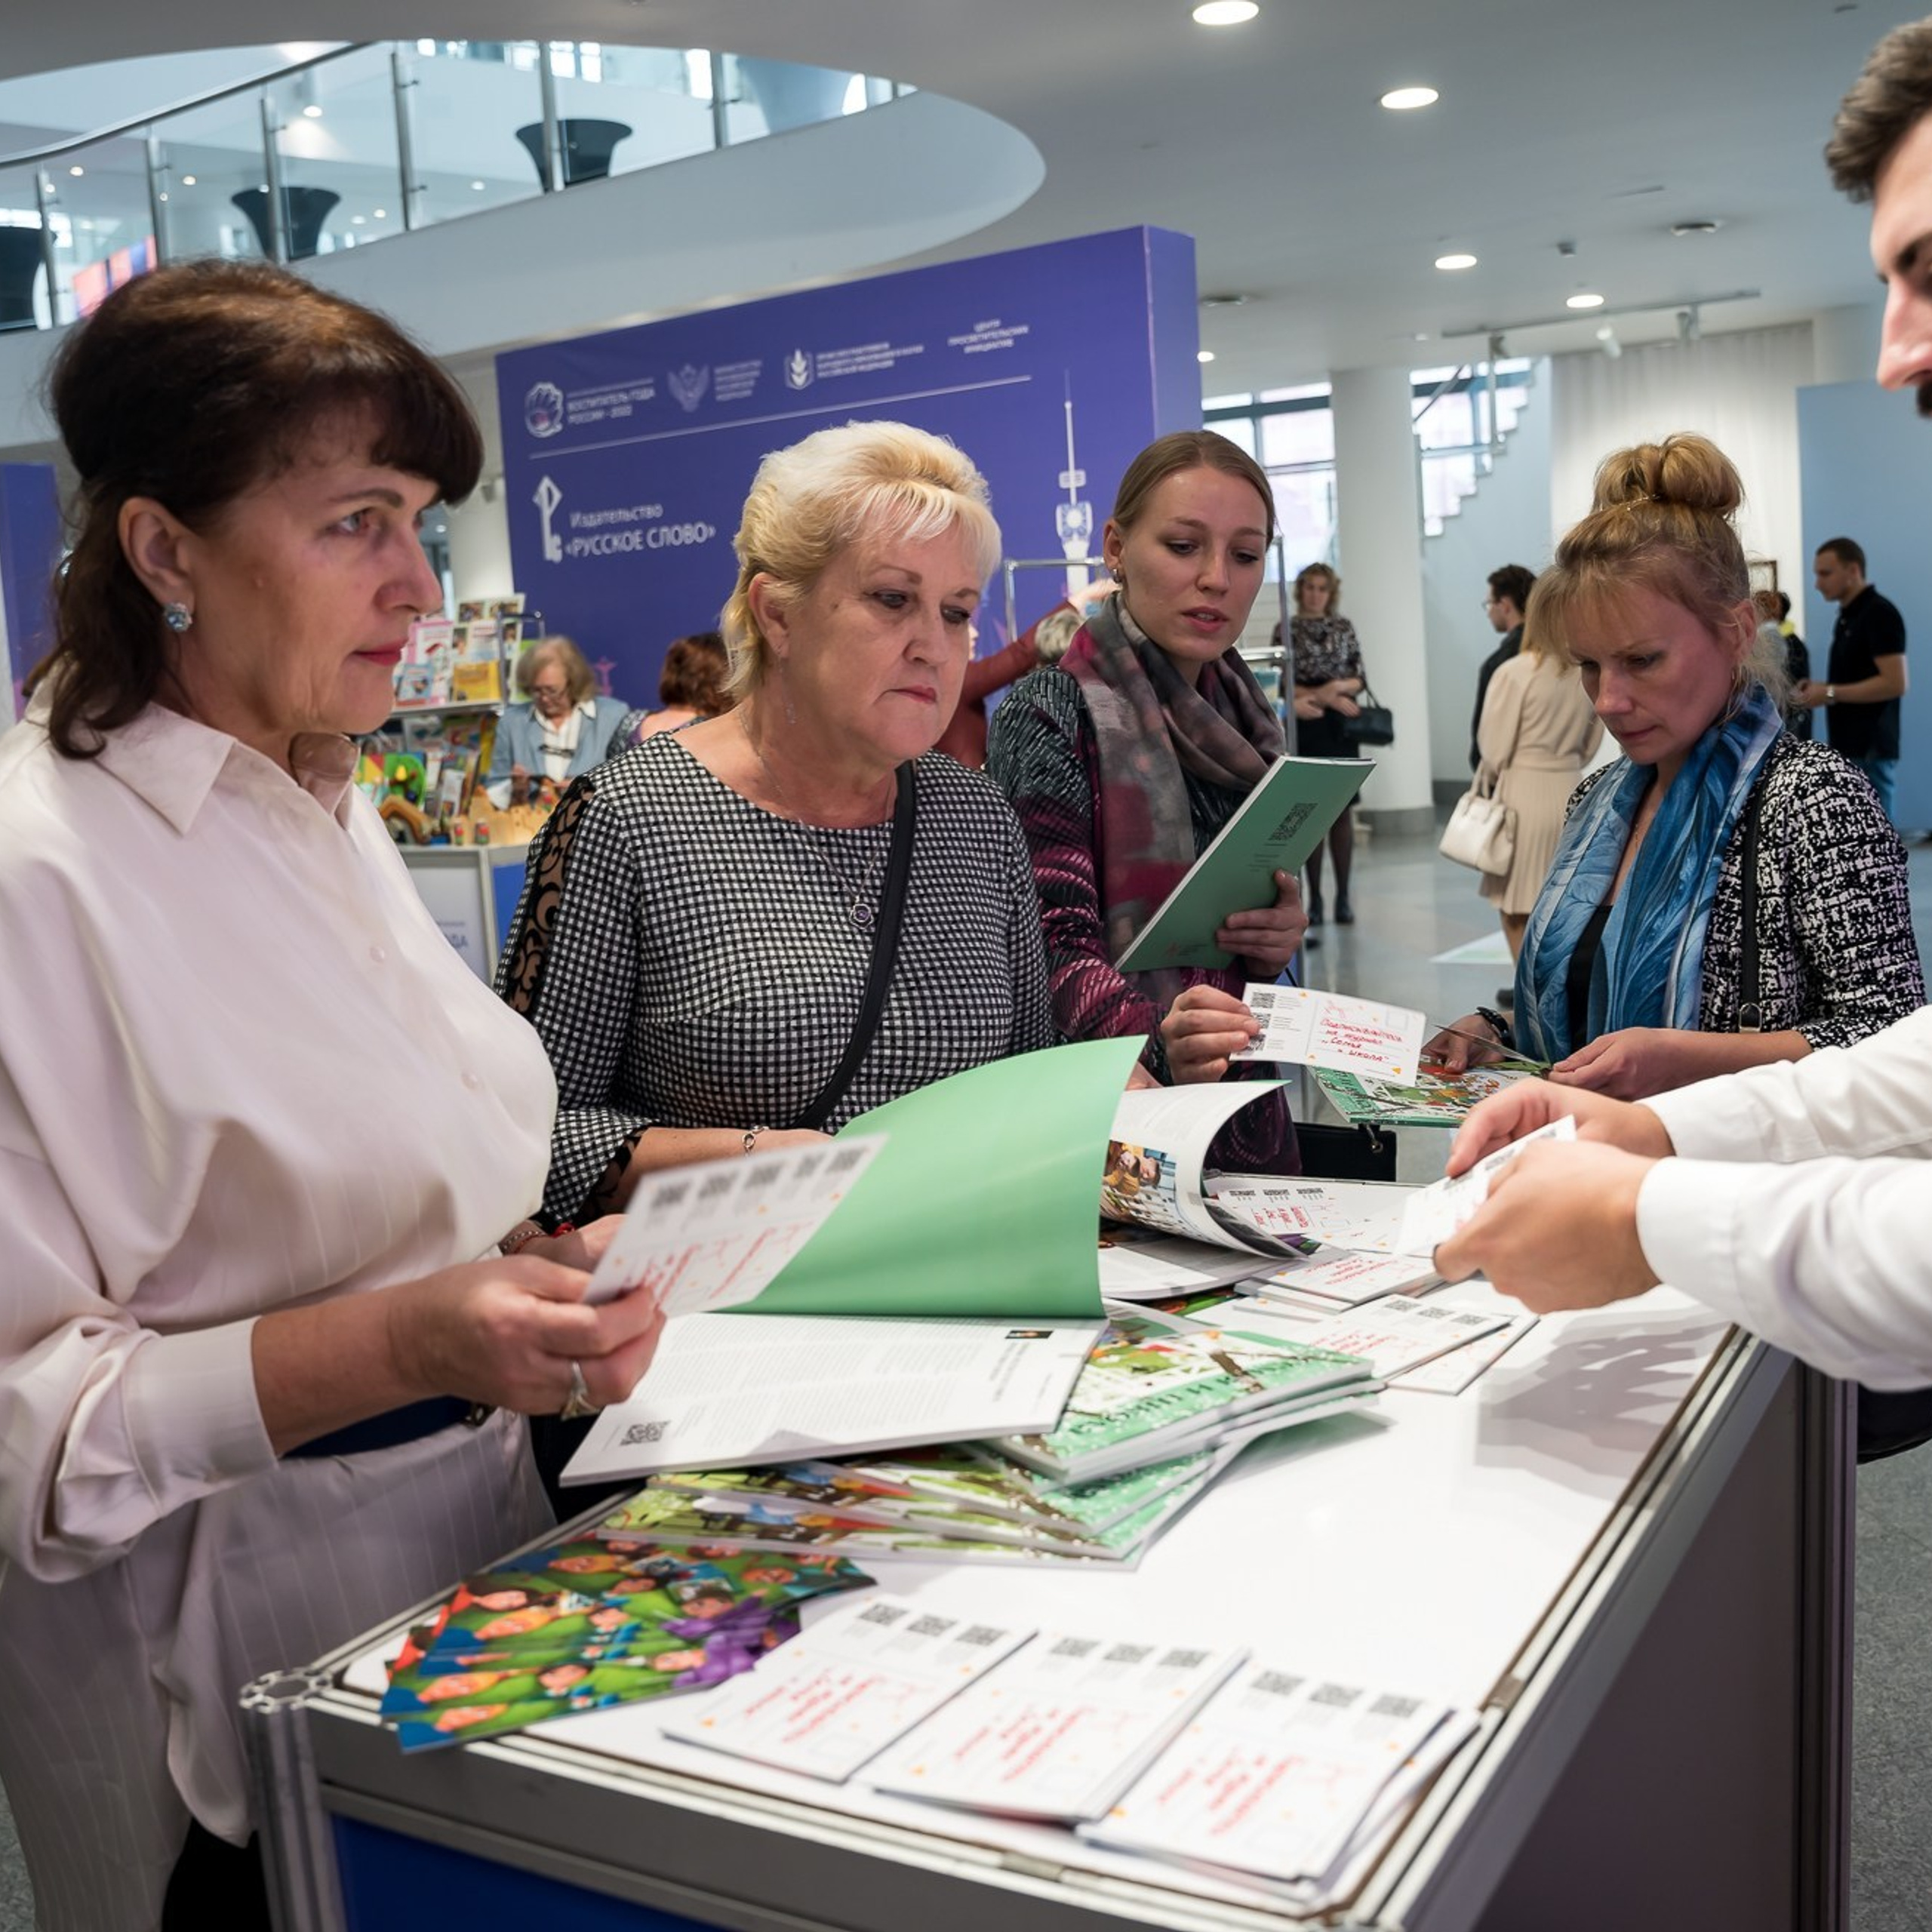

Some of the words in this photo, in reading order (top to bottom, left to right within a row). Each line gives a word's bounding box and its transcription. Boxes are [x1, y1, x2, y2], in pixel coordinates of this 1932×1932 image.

[570, 503, 663, 528] Издательство
[566, 530, 644, 557] «РУССКОЕ
[646, 521, 716, 549] СЛОВО»
